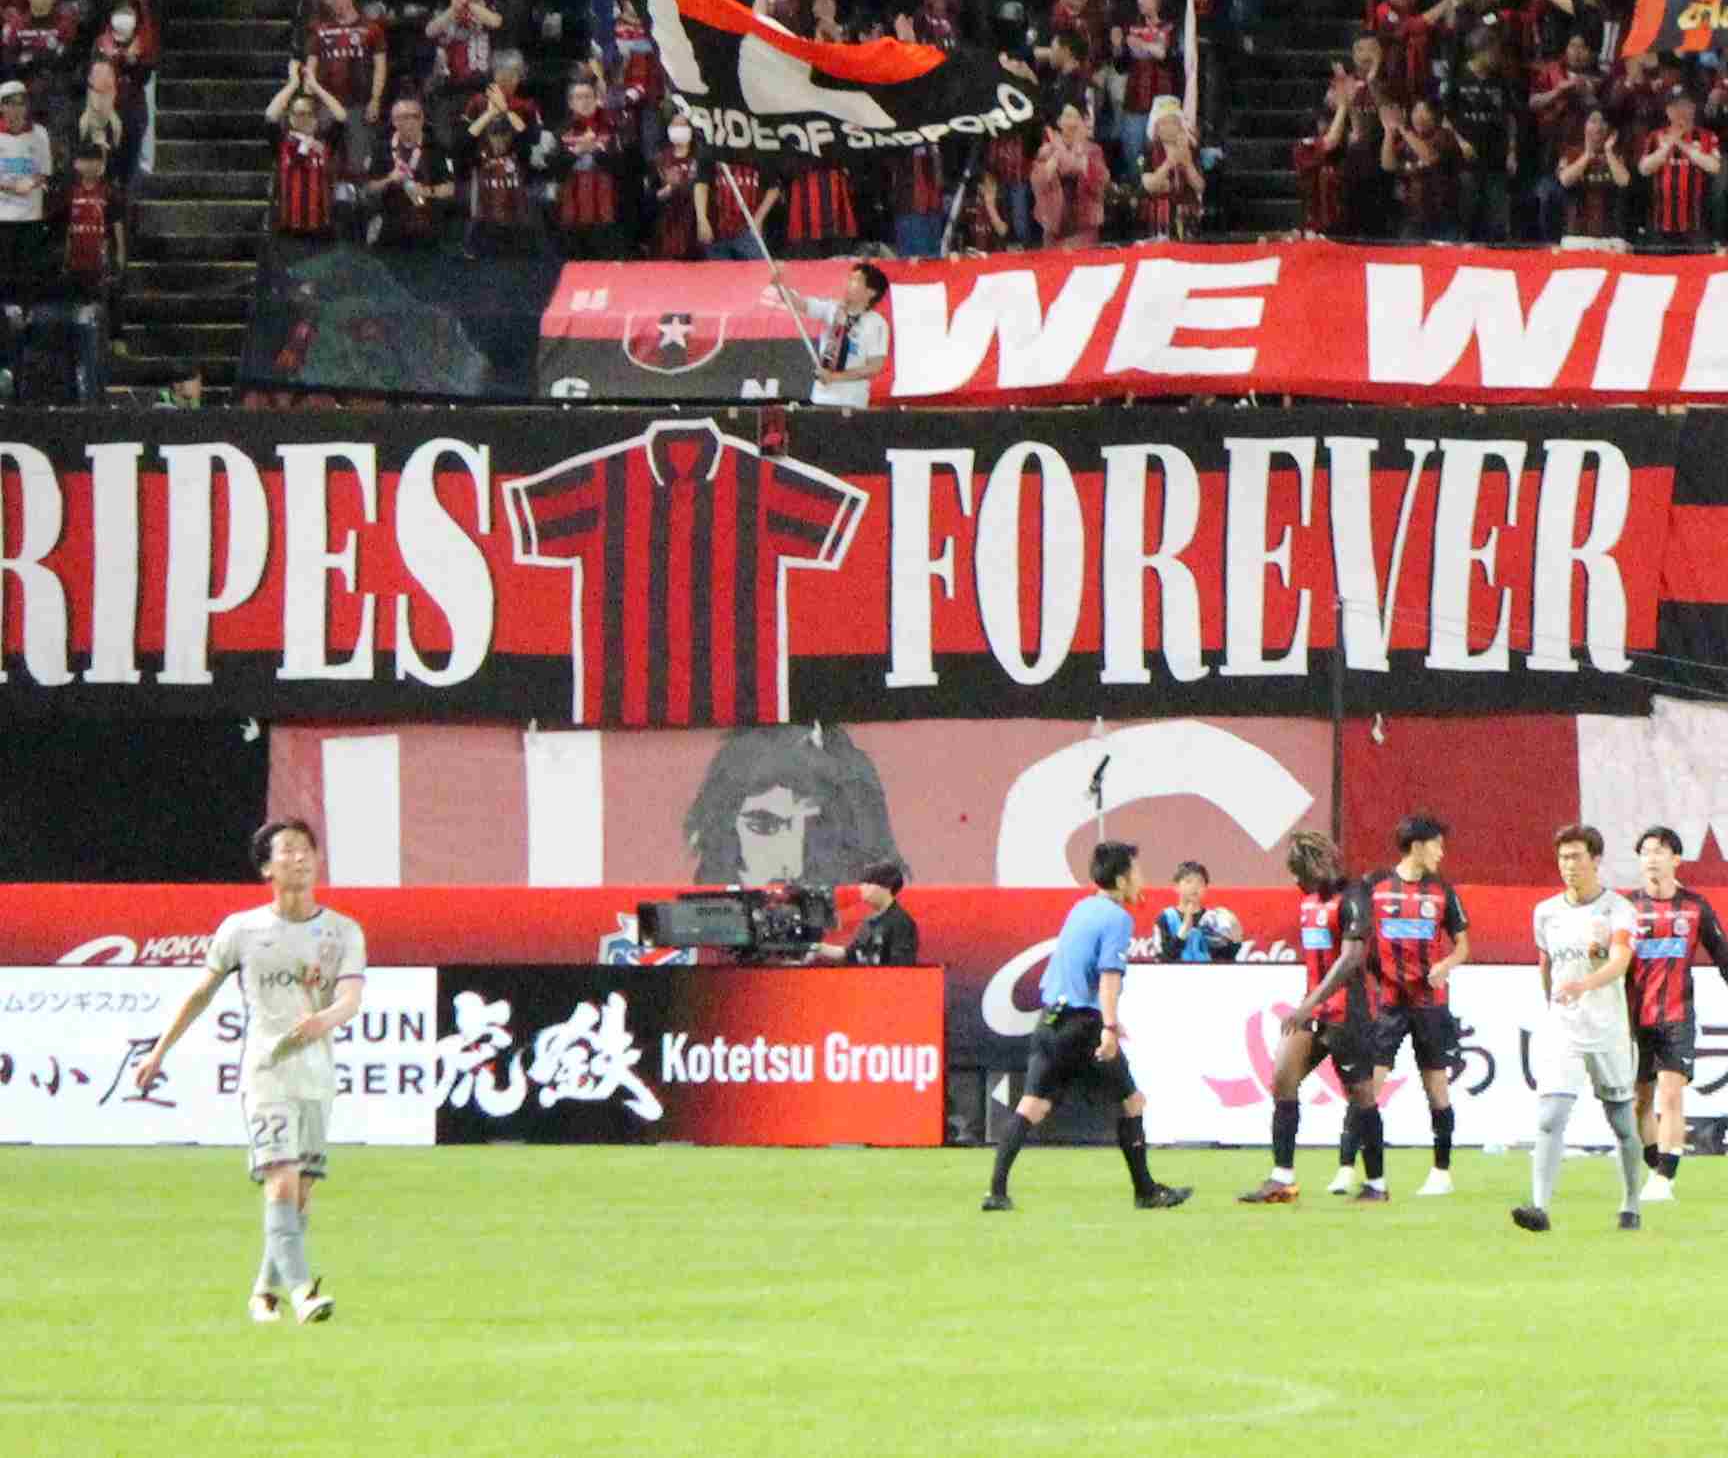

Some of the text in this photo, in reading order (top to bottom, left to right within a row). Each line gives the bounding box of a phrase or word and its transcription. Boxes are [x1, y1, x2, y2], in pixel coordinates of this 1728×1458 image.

[891, 256, 1281, 397] WE
[884, 436, 1634, 689] FOREVER
[216, 1010, 425, 1043] SGUN
[216, 1062, 425, 1096] BGER
[661, 1033, 939, 1094] Kotetsu Group
